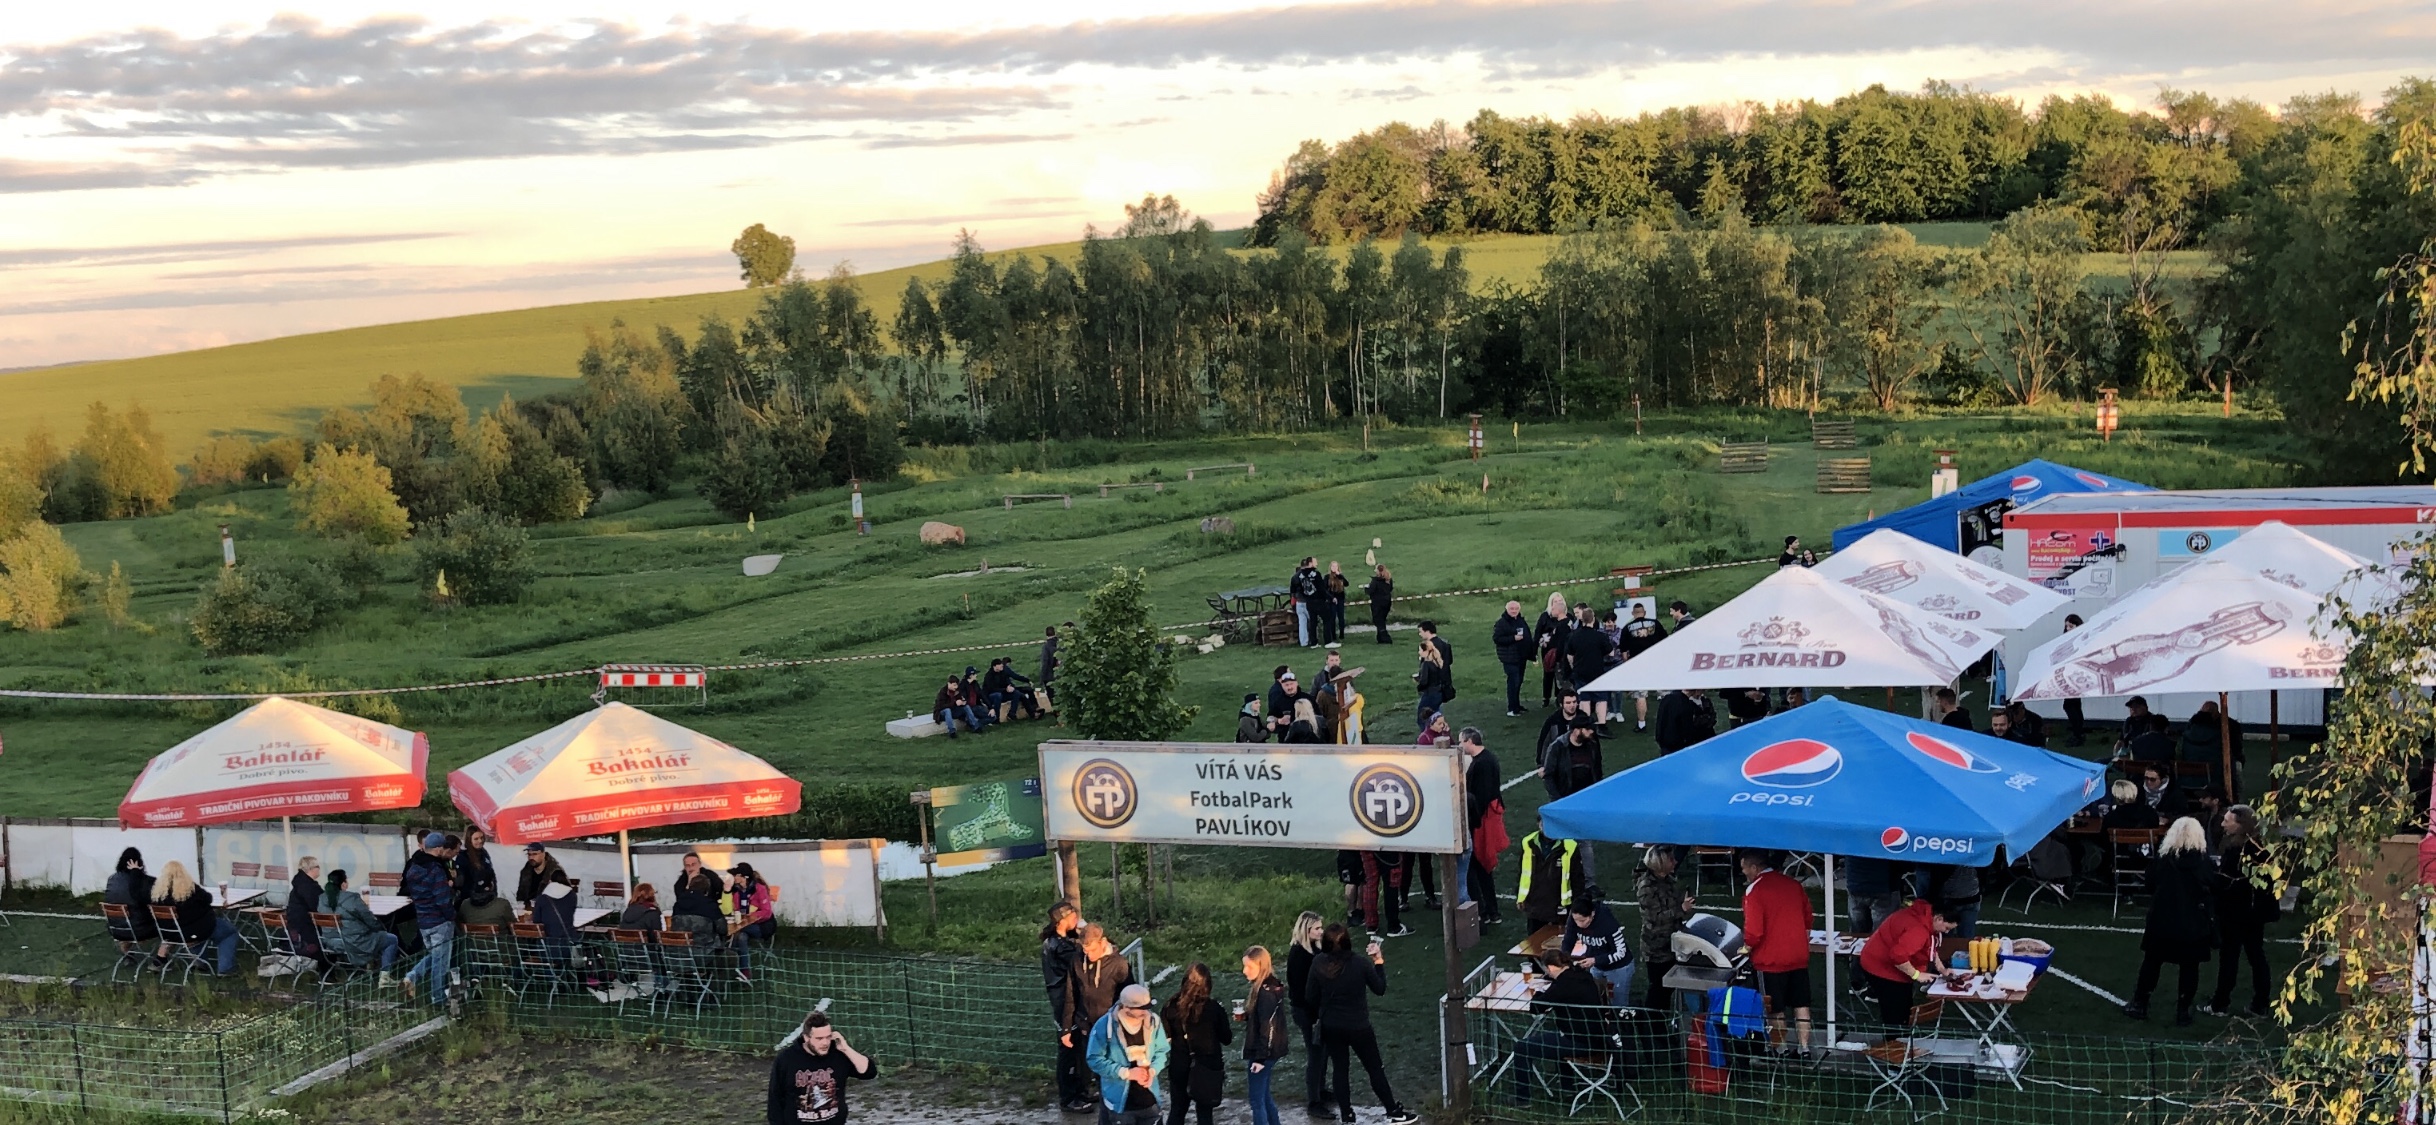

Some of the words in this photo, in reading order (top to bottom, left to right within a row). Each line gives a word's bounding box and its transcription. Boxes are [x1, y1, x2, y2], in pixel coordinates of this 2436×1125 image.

[1689, 650, 1847, 671] BERNARD
[2269, 666, 2338, 679] BERN
[223, 748, 327, 770] Bakalář
[617, 747, 653, 757] 1454
[586, 753, 692, 776] Bakalář
[1195, 758, 1240, 780] VÍTÁ
[1243, 759, 1283, 781] VÁS
[239, 769, 276, 781] Dobré
[608, 775, 647, 787] Dobré
[199, 800, 243, 816] TRADIČNÍ
[244, 796, 285, 810] PIVOVAR
[286, 796, 294, 805] V
[295, 790, 350, 804] RAKOVNÍKU
[1190, 790, 1294, 809] FotbalPark
[1728, 792, 1812, 806] pepsi
[574, 807, 620, 824] TRADIČNÍ
[620, 803, 663, 818] PIVOVAR
[664, 802, 672, 812] V
[673, 797, 729, 812] RAKOVNÍKU
[1195, 814, 1291, 837] PAVLÍKOV
[1913, 836, 1973, 855] pepsi
